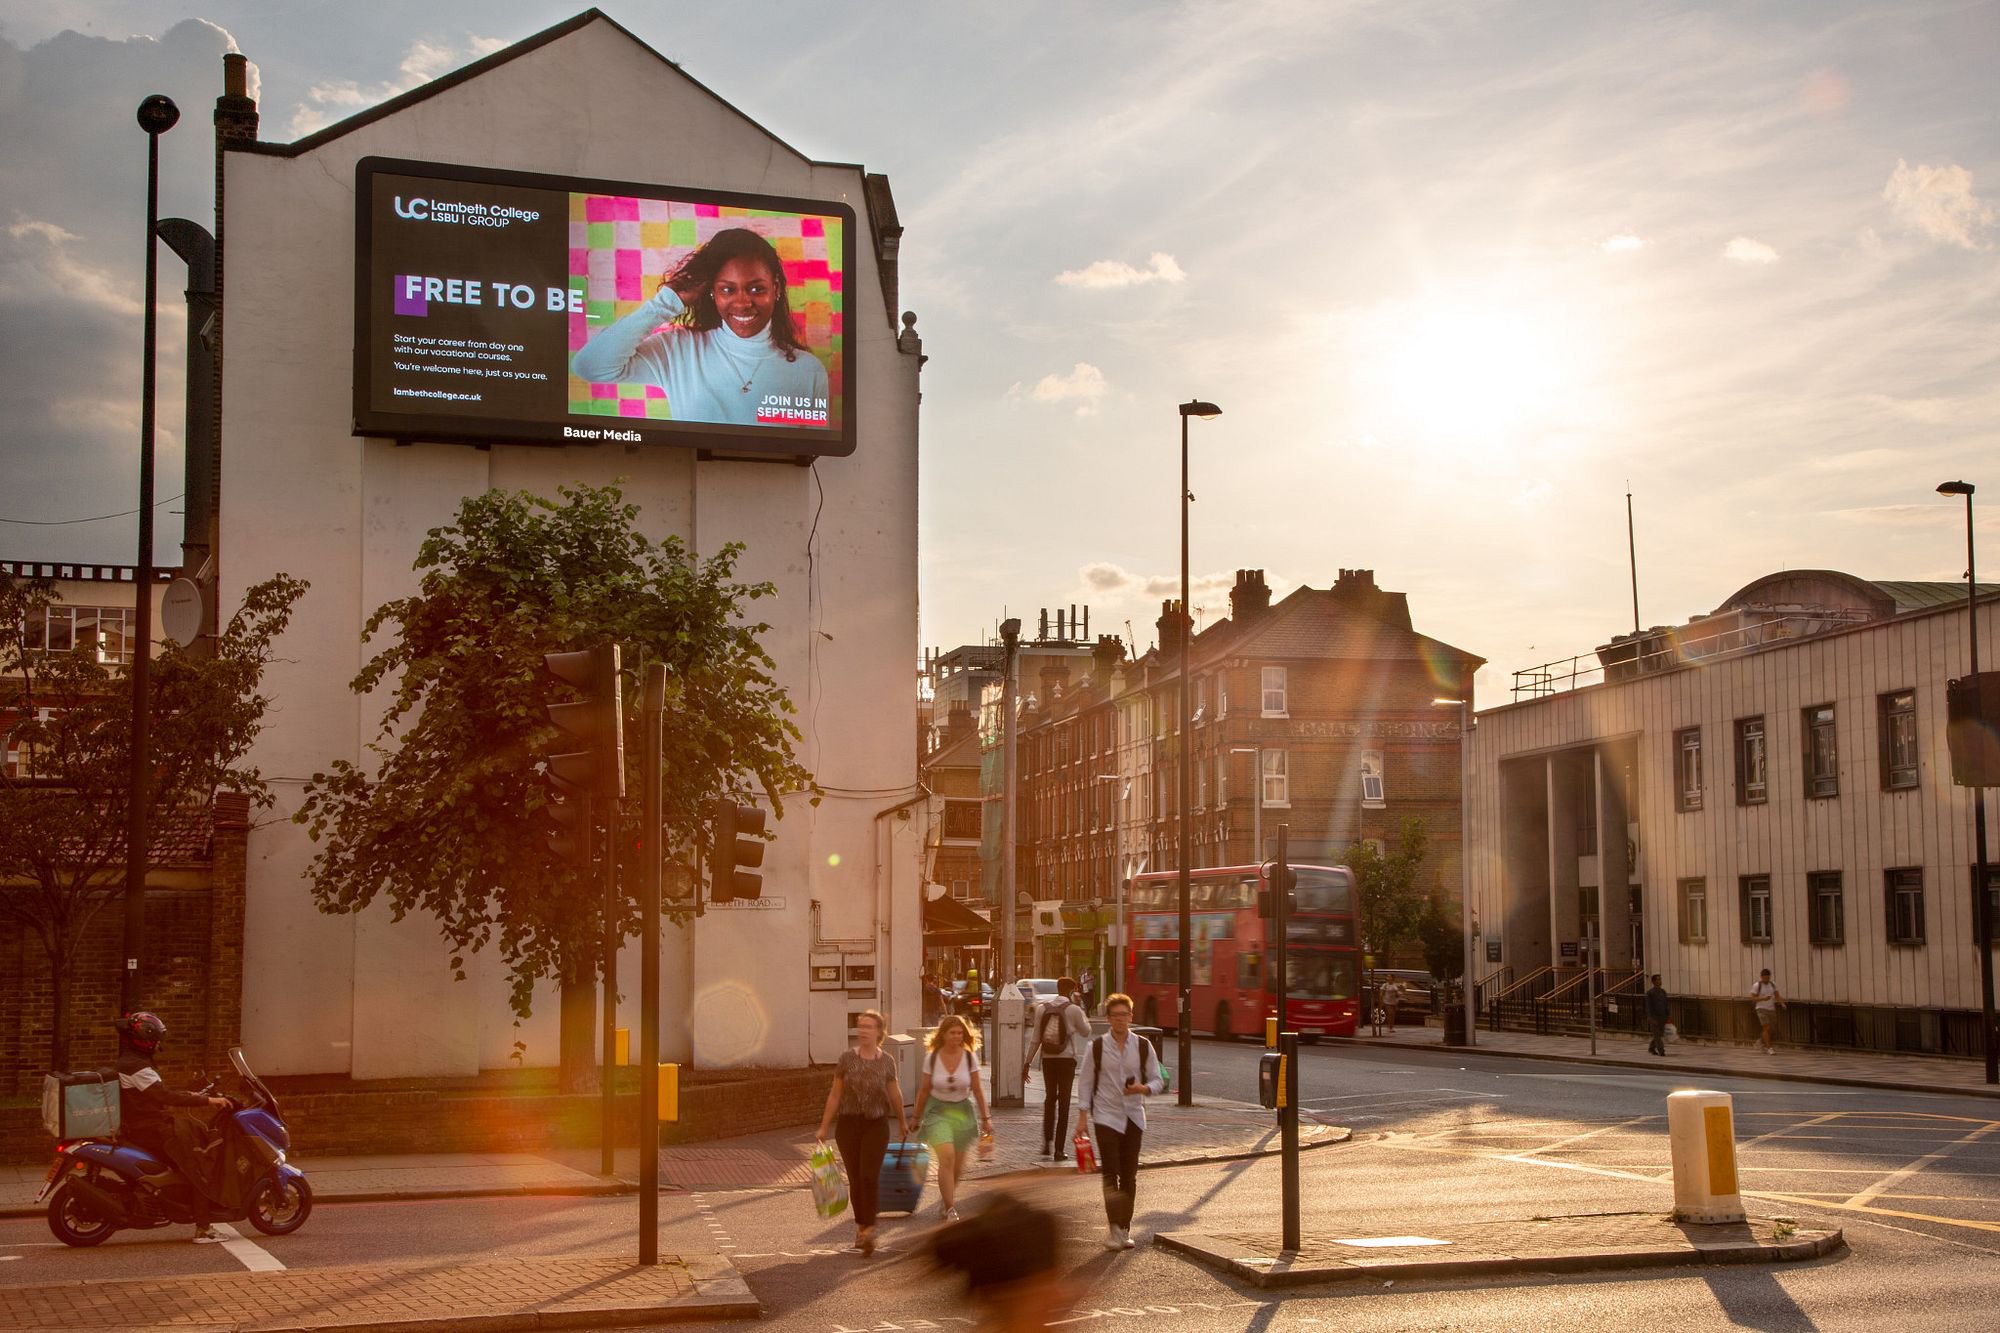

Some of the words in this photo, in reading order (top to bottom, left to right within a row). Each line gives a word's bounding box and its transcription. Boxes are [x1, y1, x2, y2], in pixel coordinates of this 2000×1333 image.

[431, 199, 487, 215] Lambeth
[490, 205, 540, 222] College
[431, 211, 459, 223] LSBU
[468, 216, 510, 228] GROUP
[406, 275, 482, 305] FREE
[492, 282, 536, 309] TO
[394, 334, 416, 344] Start
[417, 337, 437, 346] your
[438, 339, 466, 347] career
[467, 340, 488, 349] from
[489, 341, 506, 352] day
[507, 344, 524, 352] one
[394, 345, 413, 354] with
[430, 348, 476, 359] vocational
[478, 352, 513, 361] courses.
[422, 364, 461, 374] welcome
[463, 366, 484, 377] here,
[485, 368, 501, 378] just
[502, 370, 513, 378] as
[514, 371, 530, 380] you
[531, 372, 548, 381] are.
[393, 387, 482, 401] lambethcollege.ac.uk
[761, 394, 791, 406] JOIN
[795, 396, 811, 408] US
[815, 398, 827, 409] IN
[757, 406, 827, 422] SEPTEMBER
[563, 426, 601, 439] Bauer
[603, 429, 642, 442] Media
[748, 899, 771, 907] ROAD
